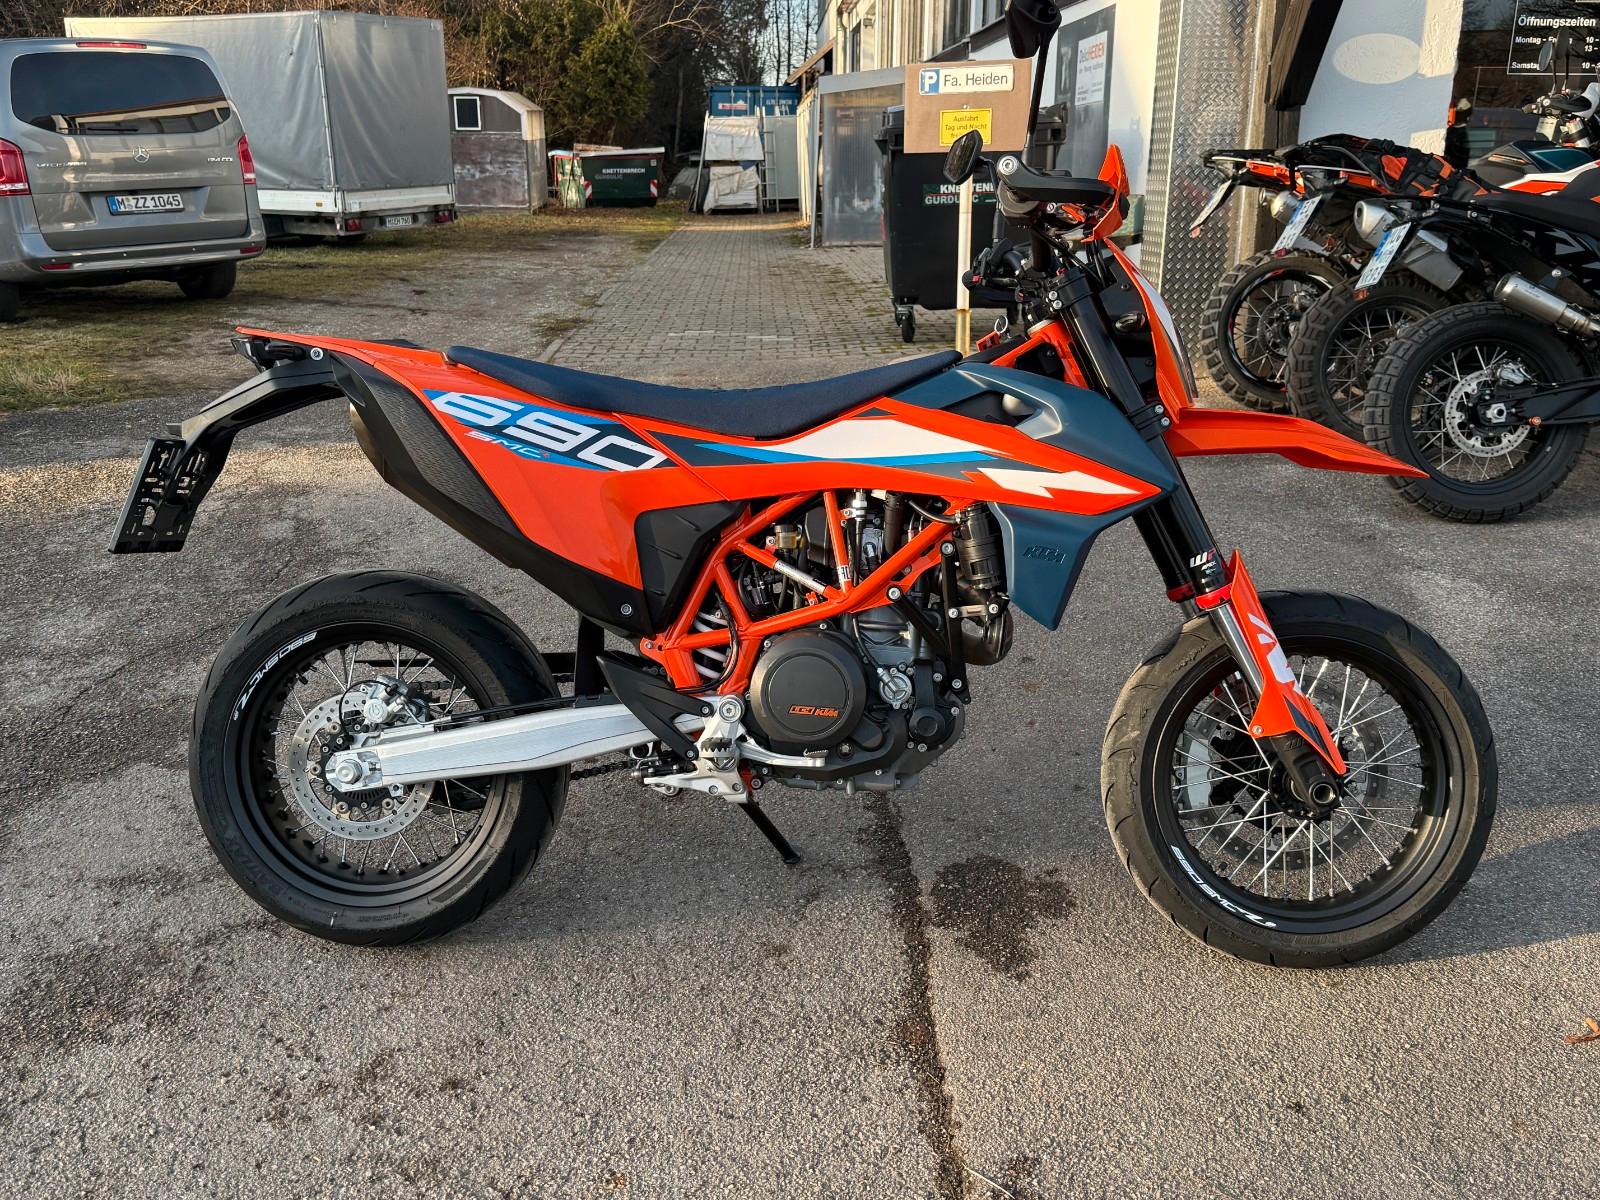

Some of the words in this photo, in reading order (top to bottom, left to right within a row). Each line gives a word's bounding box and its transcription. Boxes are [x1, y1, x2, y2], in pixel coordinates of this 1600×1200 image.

[1518, 15, 1596, 28] Öffnungszeiten
[1515, 36, 1541, 44] Montag
[944, 75, 961, 87] Fa.
[966, 73, 1008, 86] Heiden
[117, 199, 126, 210] M
[134, 196, 150, 209] ZZ
[152, 195, 181, 208] 1045
[431, 391, 667, 472] 690
[464, 430, 542, 459] SMC
[1023, 545, 1066, 564] KTM
